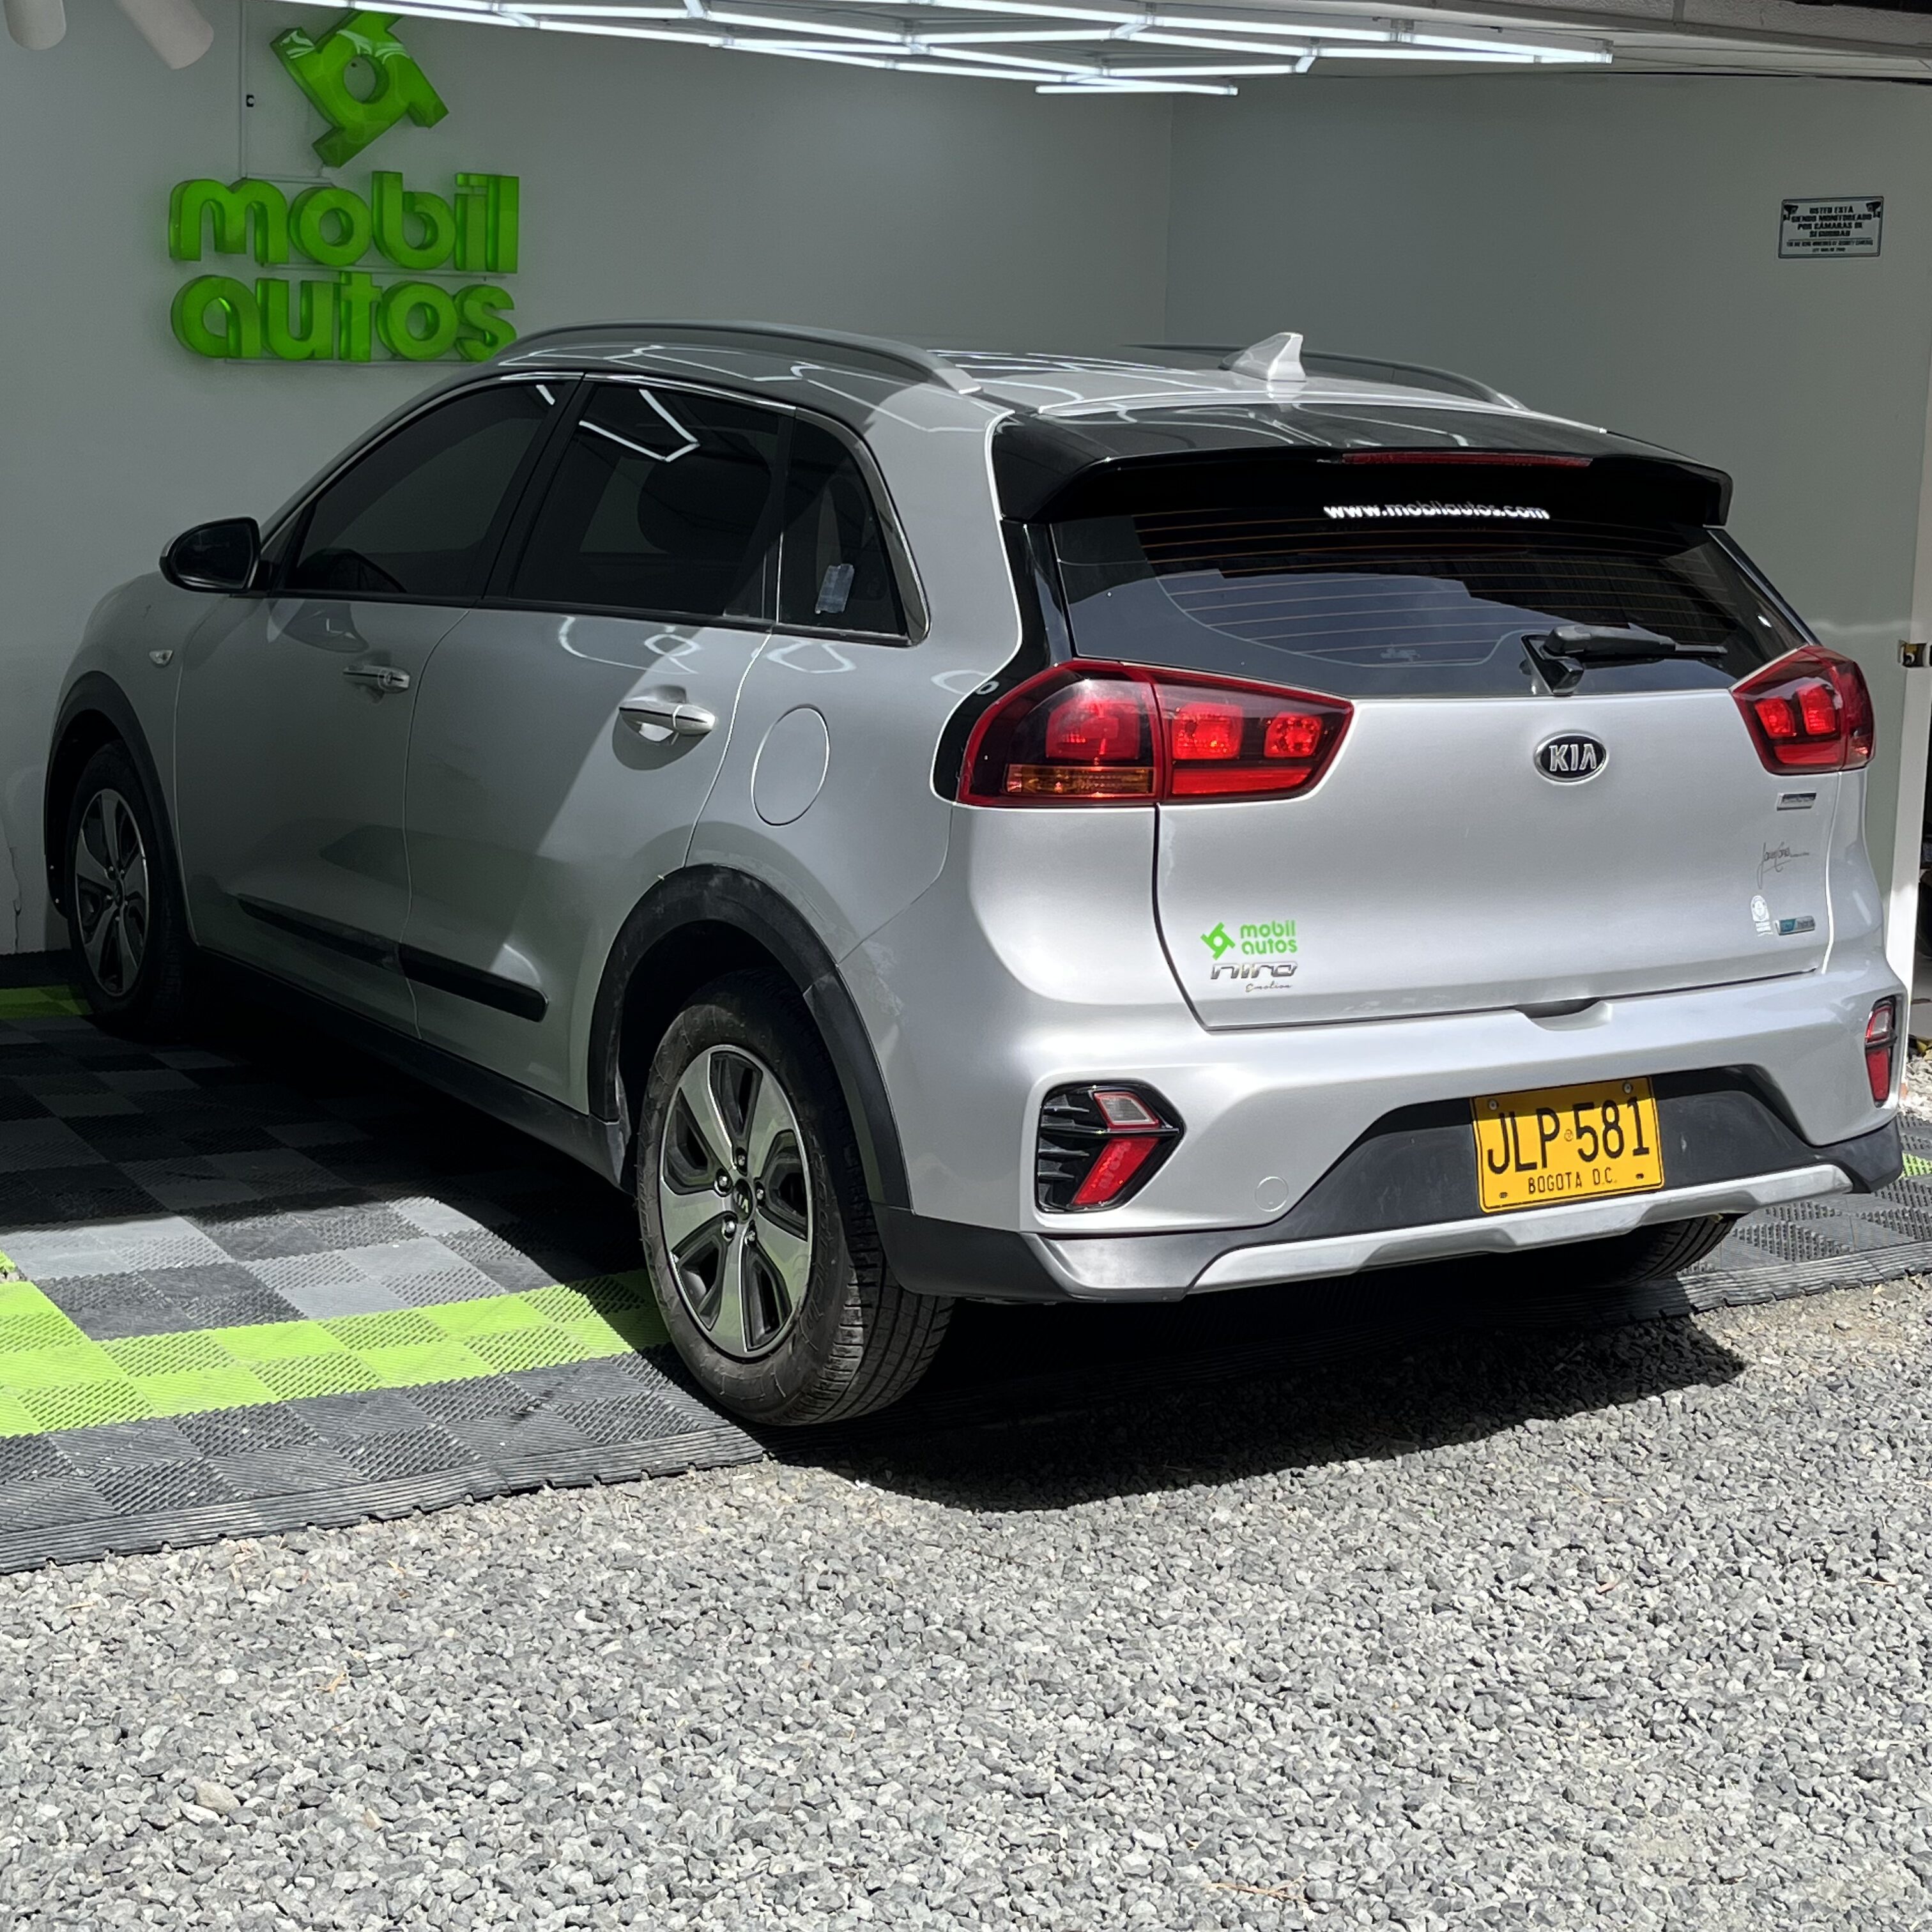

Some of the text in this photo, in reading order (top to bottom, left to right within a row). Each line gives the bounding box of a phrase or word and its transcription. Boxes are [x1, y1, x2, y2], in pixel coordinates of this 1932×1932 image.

[168, 171, 519, 273] mobil
[171, 271, 518, 362] autos
[1323, 500, 1551, 520] www.mobilautos.com
[1548, 743, 1597, 772] KIA
[1239, 920, 1296, 939] mobil
[1241, 939, 1298, 955] autos
[1210, 961, 1299, 980] niro
[1487, 1096, 1650, 1174] JLP 581
[1528, 1171, 1582, 1194] BOGOTA
